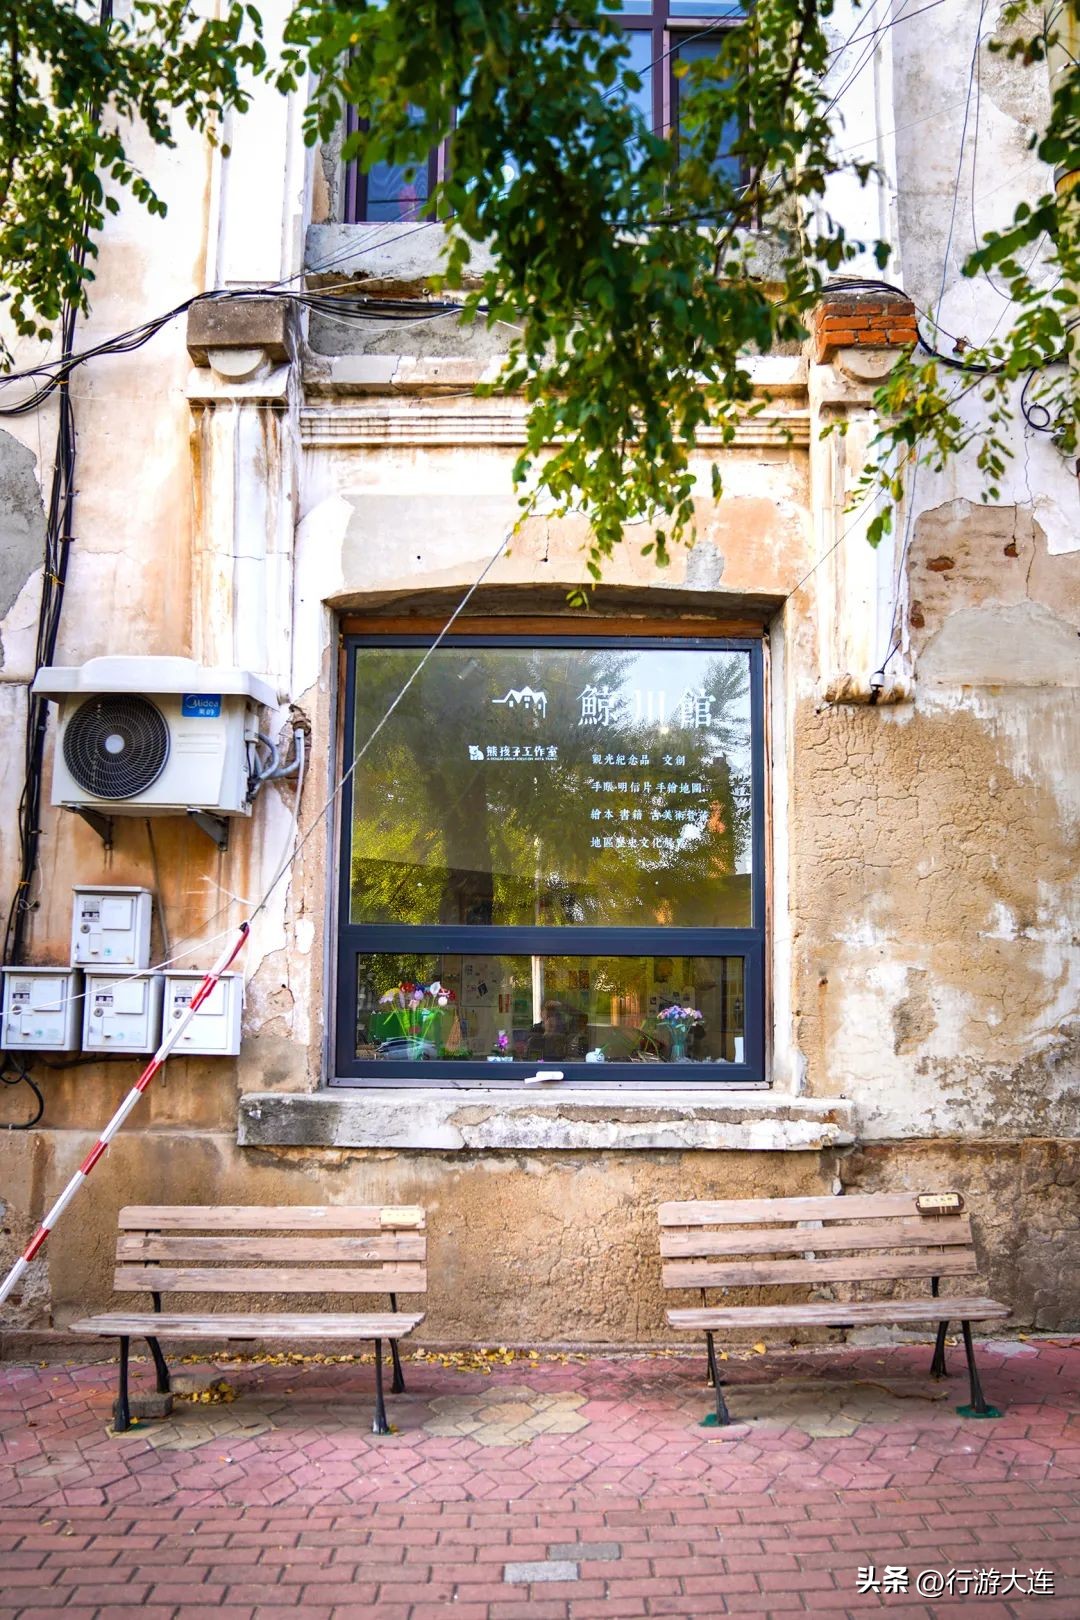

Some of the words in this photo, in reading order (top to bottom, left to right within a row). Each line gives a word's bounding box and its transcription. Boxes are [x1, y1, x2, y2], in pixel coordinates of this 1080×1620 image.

[185, 694, 219, 709] Midea
[486, 745, 559, 757] 熊孩子工作室
[591, 753, 650, 766] 觀光紀念品
[662, 754, 686, 766] 文創
